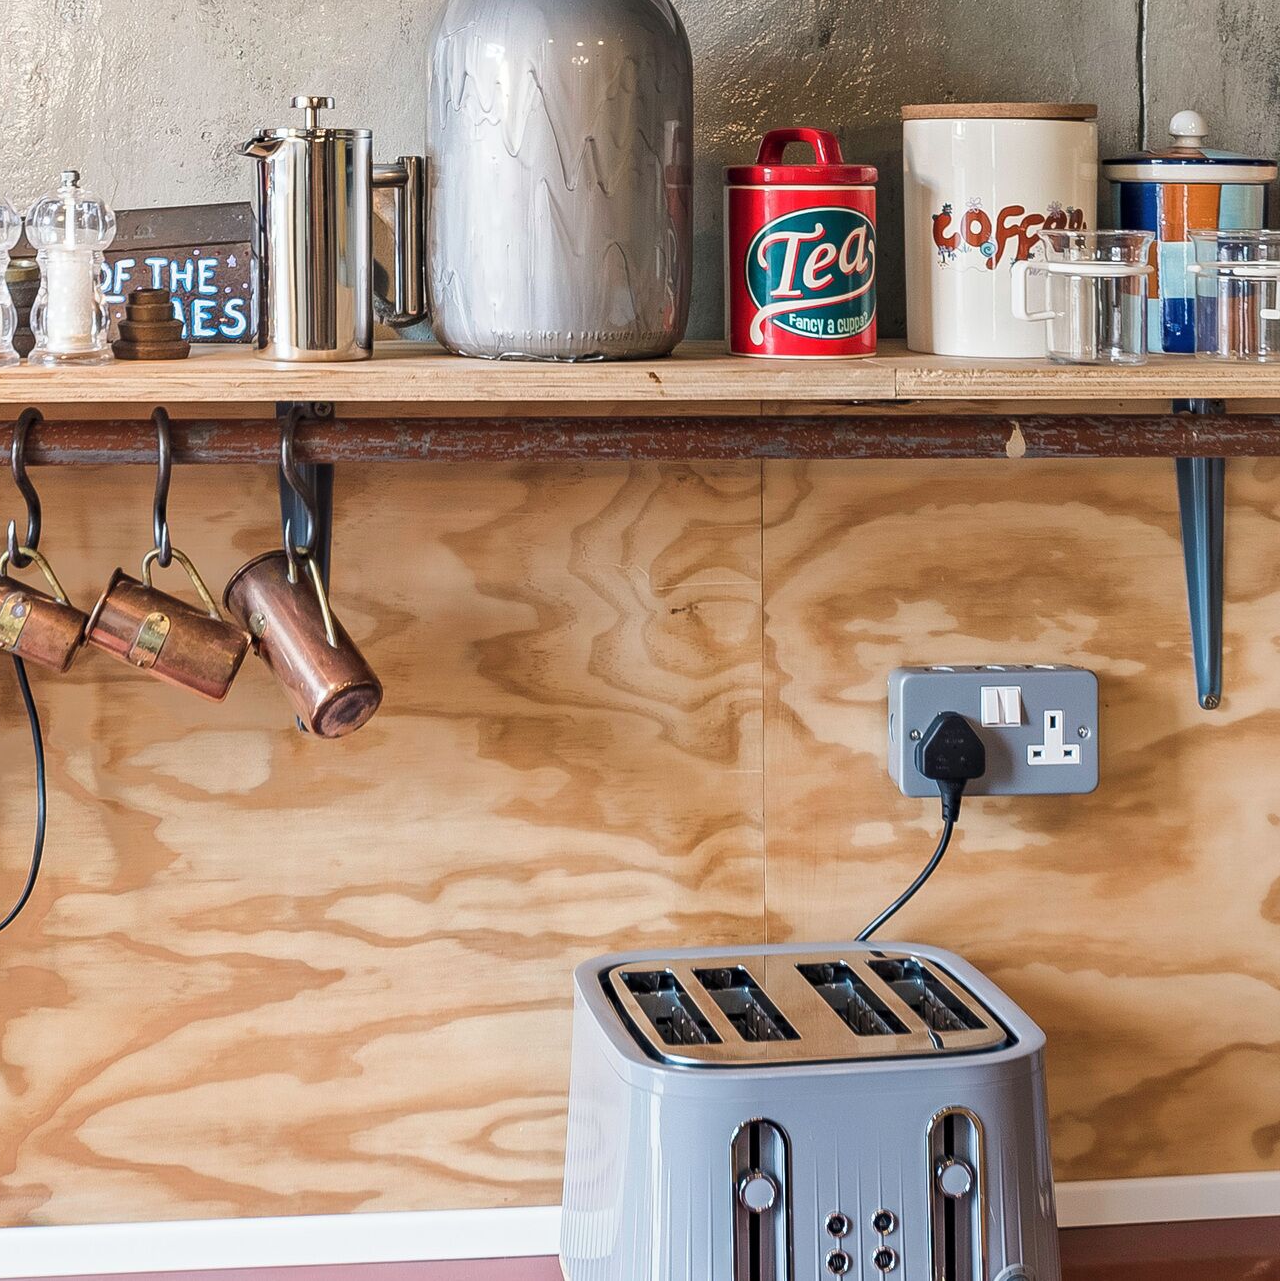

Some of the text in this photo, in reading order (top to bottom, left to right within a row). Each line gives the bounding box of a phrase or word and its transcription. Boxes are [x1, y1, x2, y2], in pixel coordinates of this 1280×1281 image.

[144, 256, 219, 295] THE
[757, 222, 870, 298] Tea
[788, 311, 869, 338] Fancy a cuppa?
